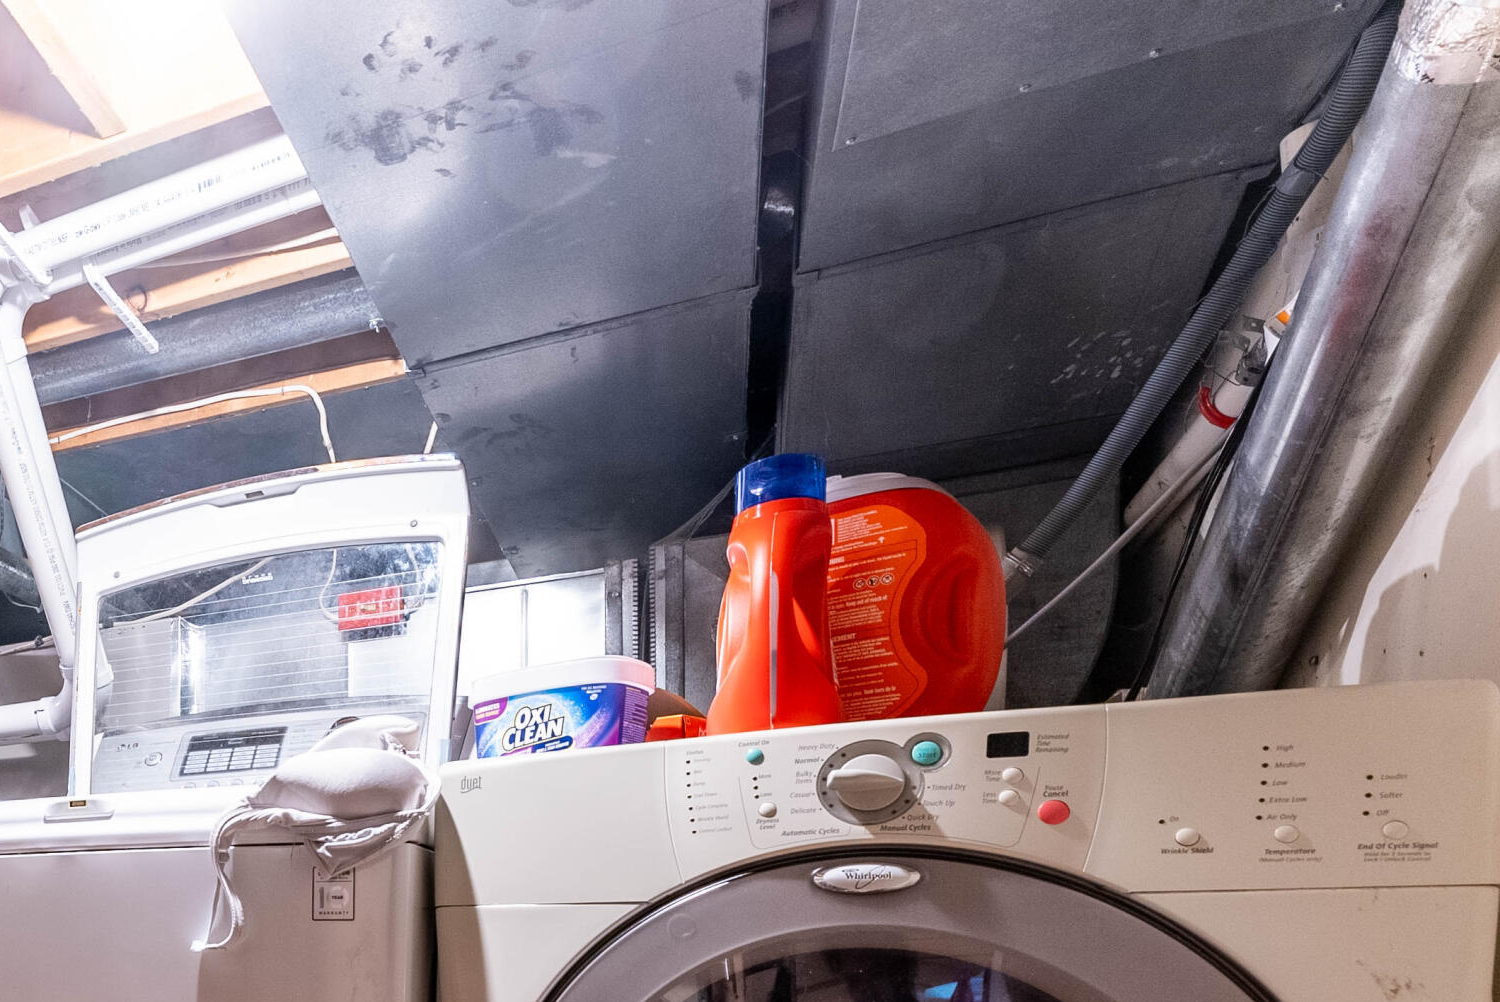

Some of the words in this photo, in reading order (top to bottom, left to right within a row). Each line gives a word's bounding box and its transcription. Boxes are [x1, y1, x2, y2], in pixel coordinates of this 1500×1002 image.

[515, 704, 552, 730] OXI
[502, 716, 565, 751] CLEAN
[460, 775, 482, 790] duet
[955, 783, 966, 792] Dry
[790, 791, 812, 799] Casual
[927, 814, 939, 822] Dry
[818, 828, 840, 836] Cycles
[909, 824, 931, 833] Cycles
[1388, 842, 1410, 850] Cycle
[1412, 842, 1439, 850] Signal
[845, 871, 892, 881] Whirlpool
